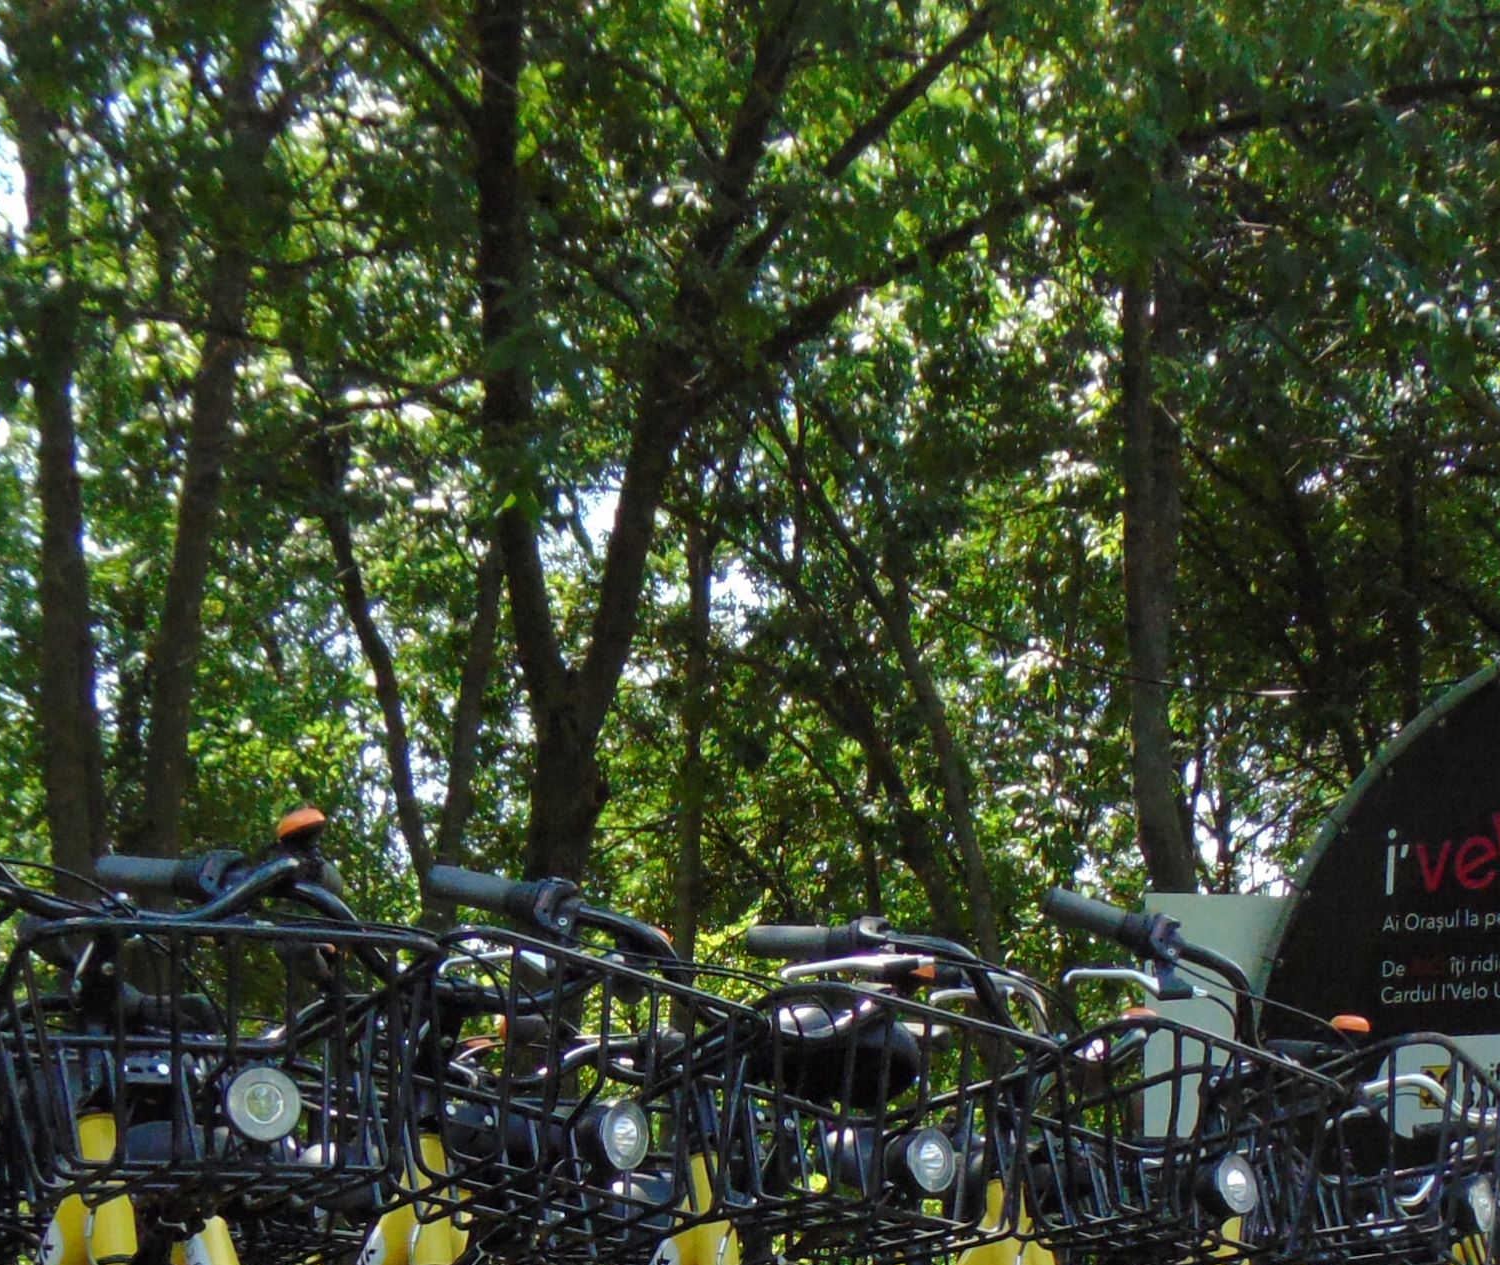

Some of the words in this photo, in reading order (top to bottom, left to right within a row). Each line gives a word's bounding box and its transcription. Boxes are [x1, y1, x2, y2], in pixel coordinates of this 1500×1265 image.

[1382, 915, 1399, 933] Ai
[1465, 908, 1479, 928] la
[1381, 960, 1406, 979] De
[1381, 982, 1437, 1005] Cardul
